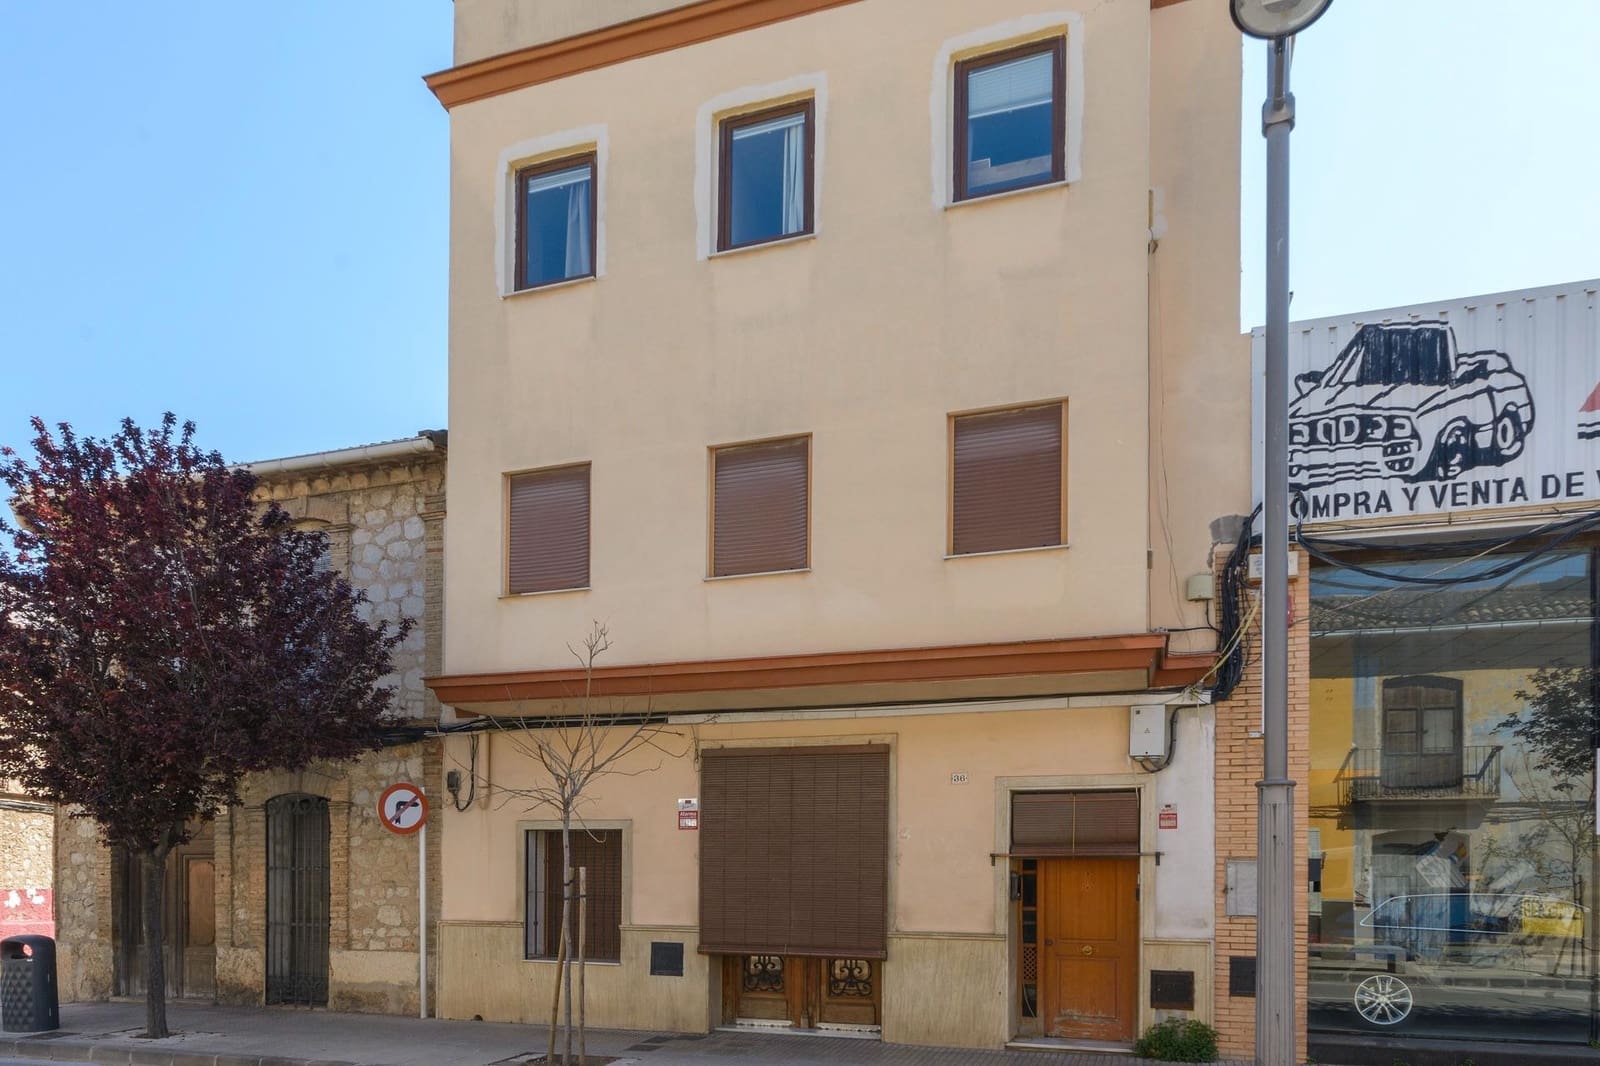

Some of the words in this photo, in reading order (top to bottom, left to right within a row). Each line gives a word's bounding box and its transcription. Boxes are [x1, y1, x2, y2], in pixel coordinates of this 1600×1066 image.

[1289, 490, 1392, 519] OMPRA
[1401, 486, 1421, 511] Y
[1429, 477, 1529, 509] VENTA
[1541, 471, 1585, 499] DE
[953, 774, 966, 782] 36
